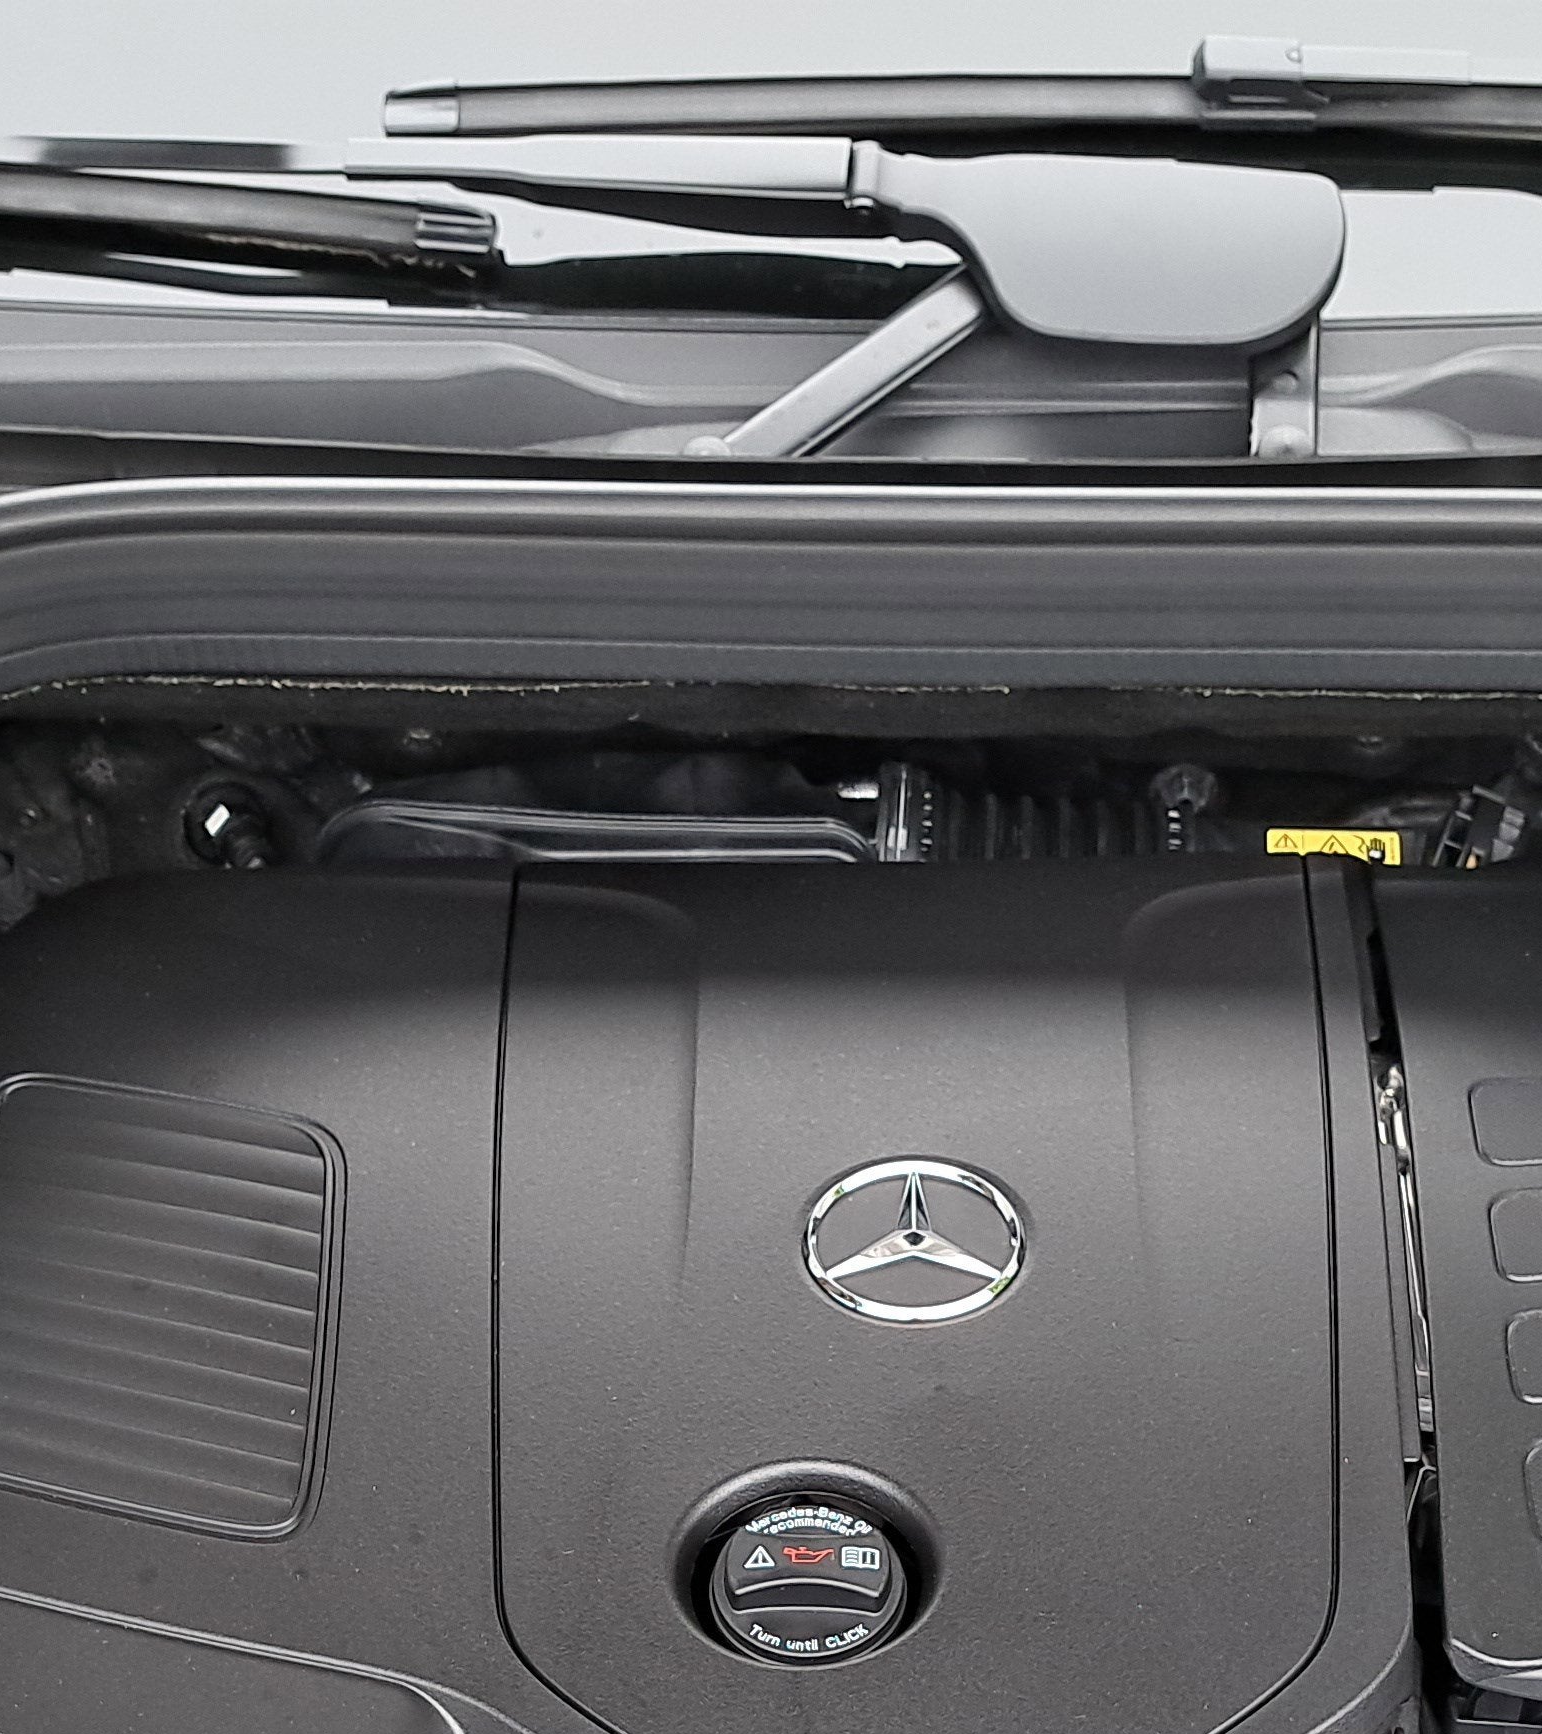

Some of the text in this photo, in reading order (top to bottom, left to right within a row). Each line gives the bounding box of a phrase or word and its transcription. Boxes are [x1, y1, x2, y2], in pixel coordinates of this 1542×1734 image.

[749, 1623, 869, 1652] Turn until CLICK
